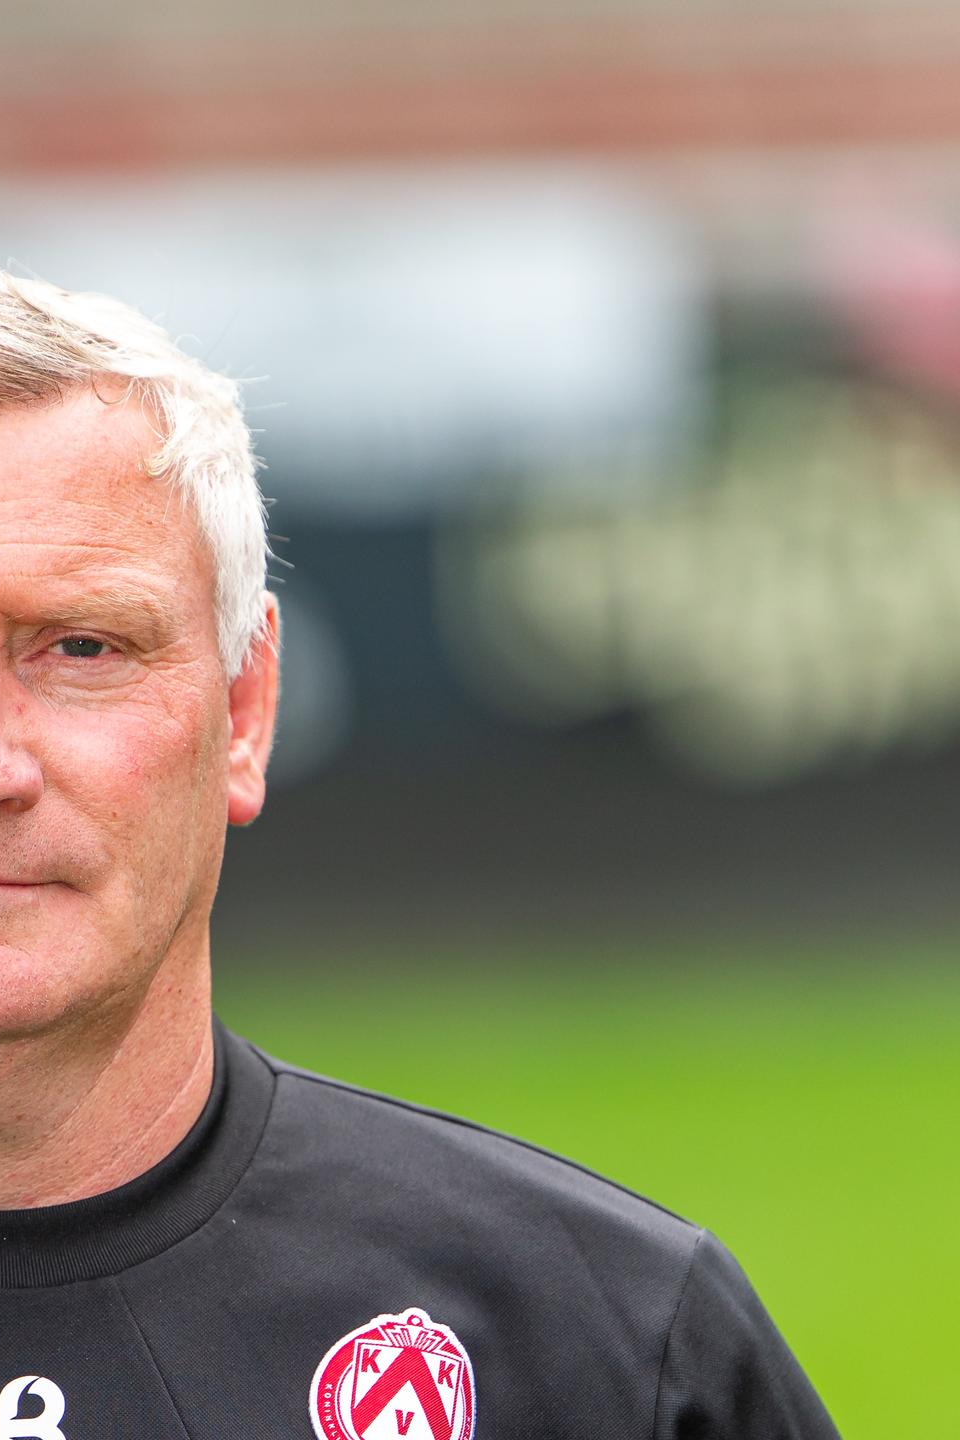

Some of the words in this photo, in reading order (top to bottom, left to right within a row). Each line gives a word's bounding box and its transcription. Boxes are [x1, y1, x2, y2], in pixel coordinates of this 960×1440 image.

[361, 1349, 381, 1374] K
[437, 1360, 456, 1389] K
[395, 1409, 415, 1436] V
